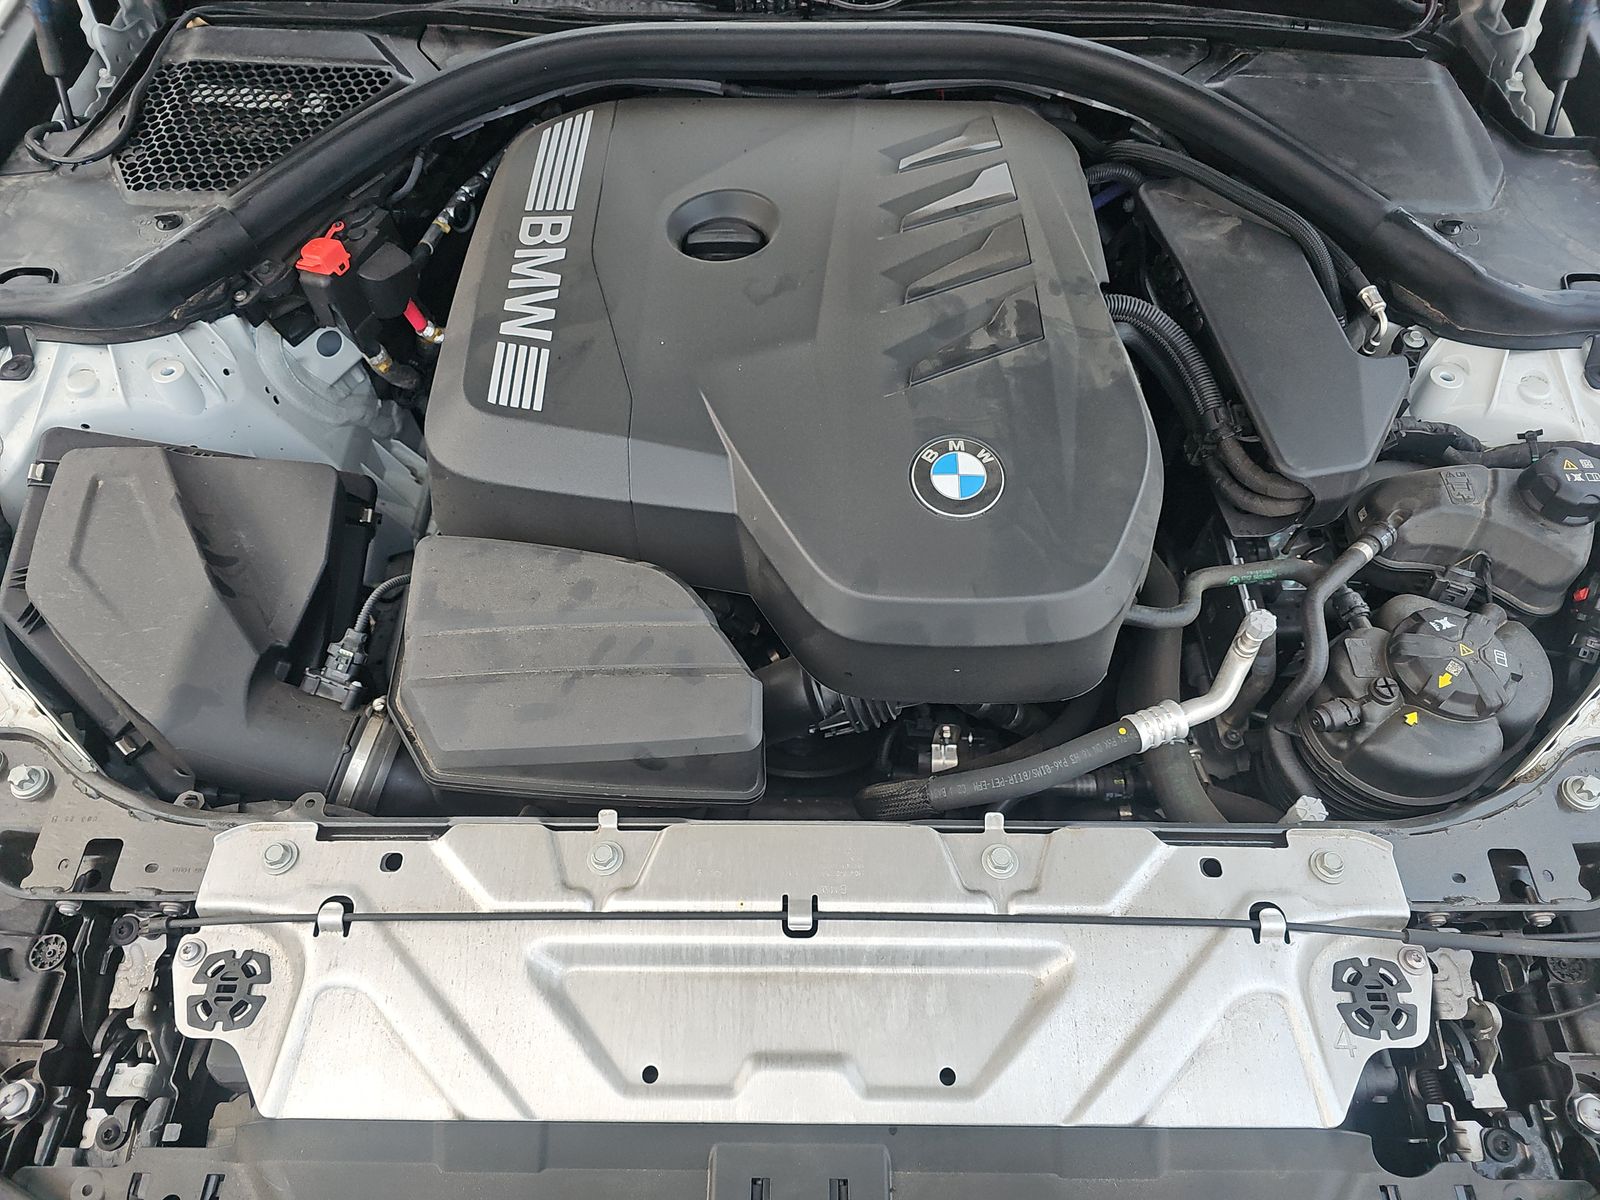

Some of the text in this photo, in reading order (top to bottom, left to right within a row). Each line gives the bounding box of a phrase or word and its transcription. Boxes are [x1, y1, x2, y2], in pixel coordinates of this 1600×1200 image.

[499, 215, 573, 341] BMW
[921, 440, 995, 464] BMW
[1333, 1022, 1357, 1058] 4
